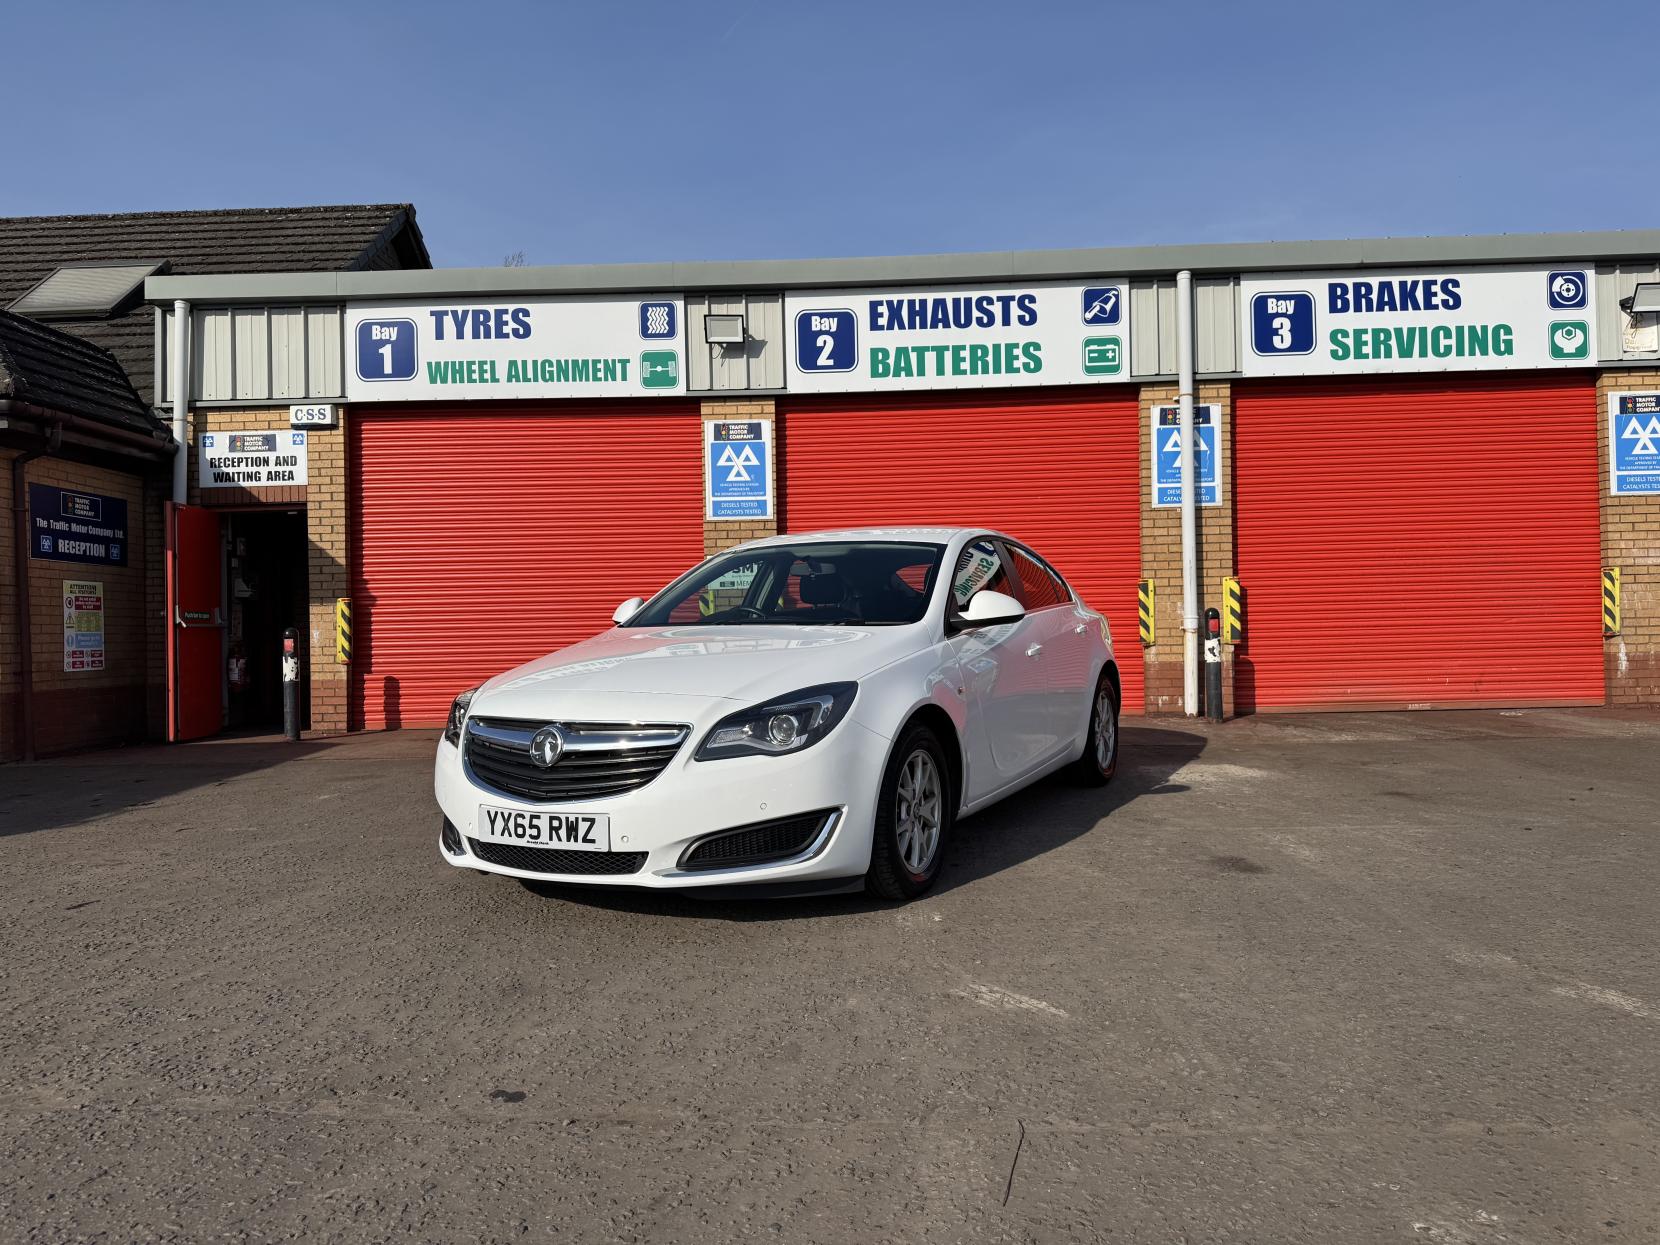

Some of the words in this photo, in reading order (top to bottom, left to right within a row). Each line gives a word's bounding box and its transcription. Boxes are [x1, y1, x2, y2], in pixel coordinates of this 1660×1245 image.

[869, 293, 1038, 331] EXHAUSTS
[1267, 298, 1295, 315] Bay
[1328, 278, 1462, 314] BRAKES
[371, 324, 398, 343] Bay
[430, 307, 532, 340] TYRES
[811, 315, 838, 333] Bay
[1272, 316, 1292, 350] 3
[816, 334, 834, 366] 2
[1329, 323, 1514, 361] SERVICING
[378, 343, 393, 375] 1
[427, 359, 500, 385] WHEEL
[506, 358, 631, 384] ALIGNMENT
[870, 341, 1043, 379] BATTERIES
[209, 456, 270, 469] RECEPTION
[274, 455, 298, 467] AND
[213, 471, 262, 483] WAITING
[266, 470, 295, 482] AREA
[36, 517, 48, 529] The
[50, 519, 70, 532] Traffic
[71, 522, 88, 533] Motor
[88, 525, 114, 538] Company
[58, 538, 105, 558] RECEPTION
[486, 809, 542, 841] YX65
[548, 815, 596, 844] RWZ
